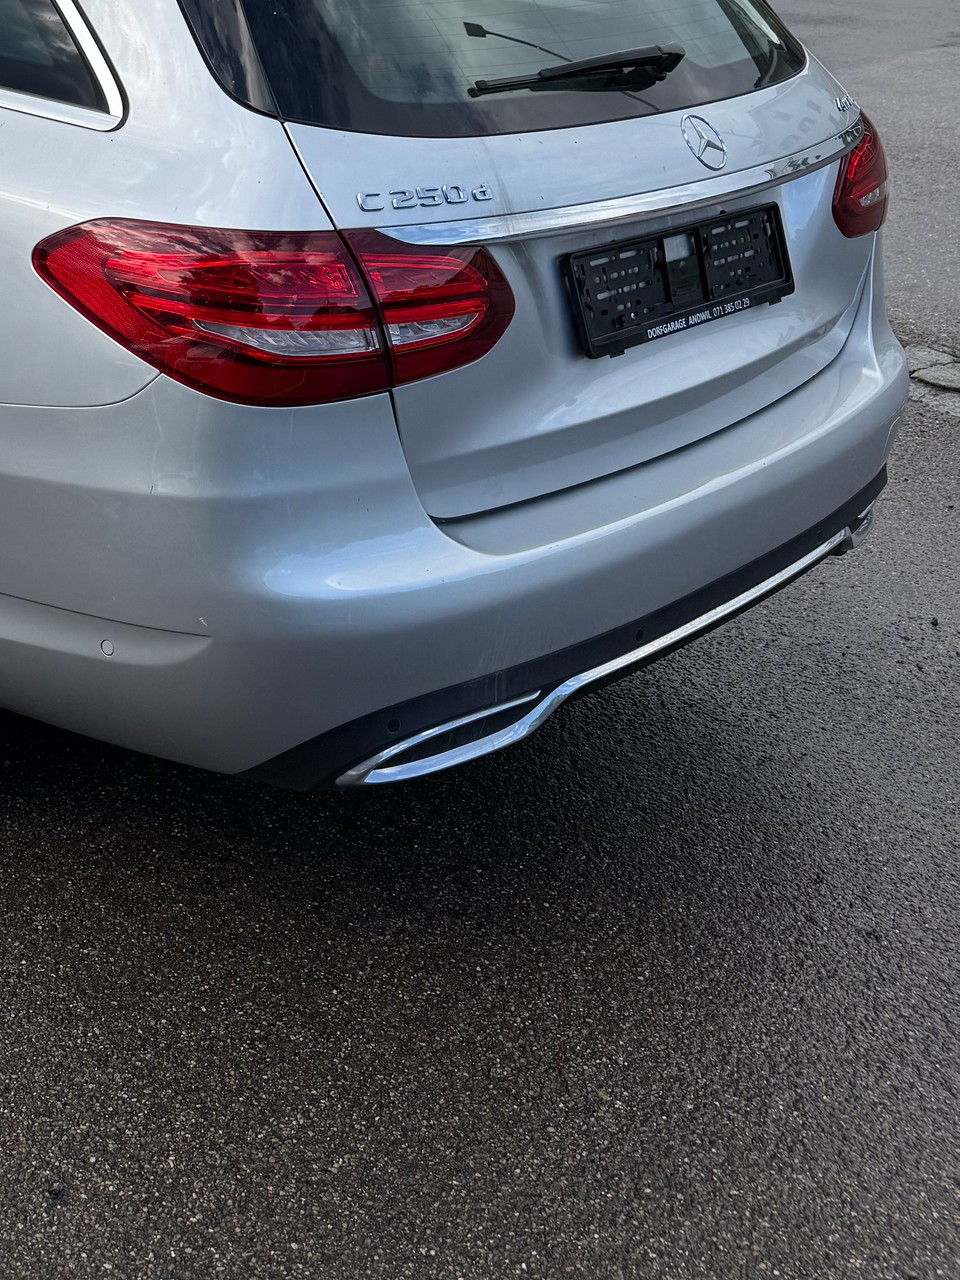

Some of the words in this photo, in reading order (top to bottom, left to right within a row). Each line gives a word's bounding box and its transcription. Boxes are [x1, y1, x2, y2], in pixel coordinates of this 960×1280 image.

[355, 191, 385, 212] C
[647, 317, 687, 339] DORFGARAGE
[688, 310, 712, 326] ANDWIL
[712, 306, 724, 317] 071
[724, 302, 735, 314] 385
[734, 300, 743, 310] 02
[742, 297, 750, 308] 29
